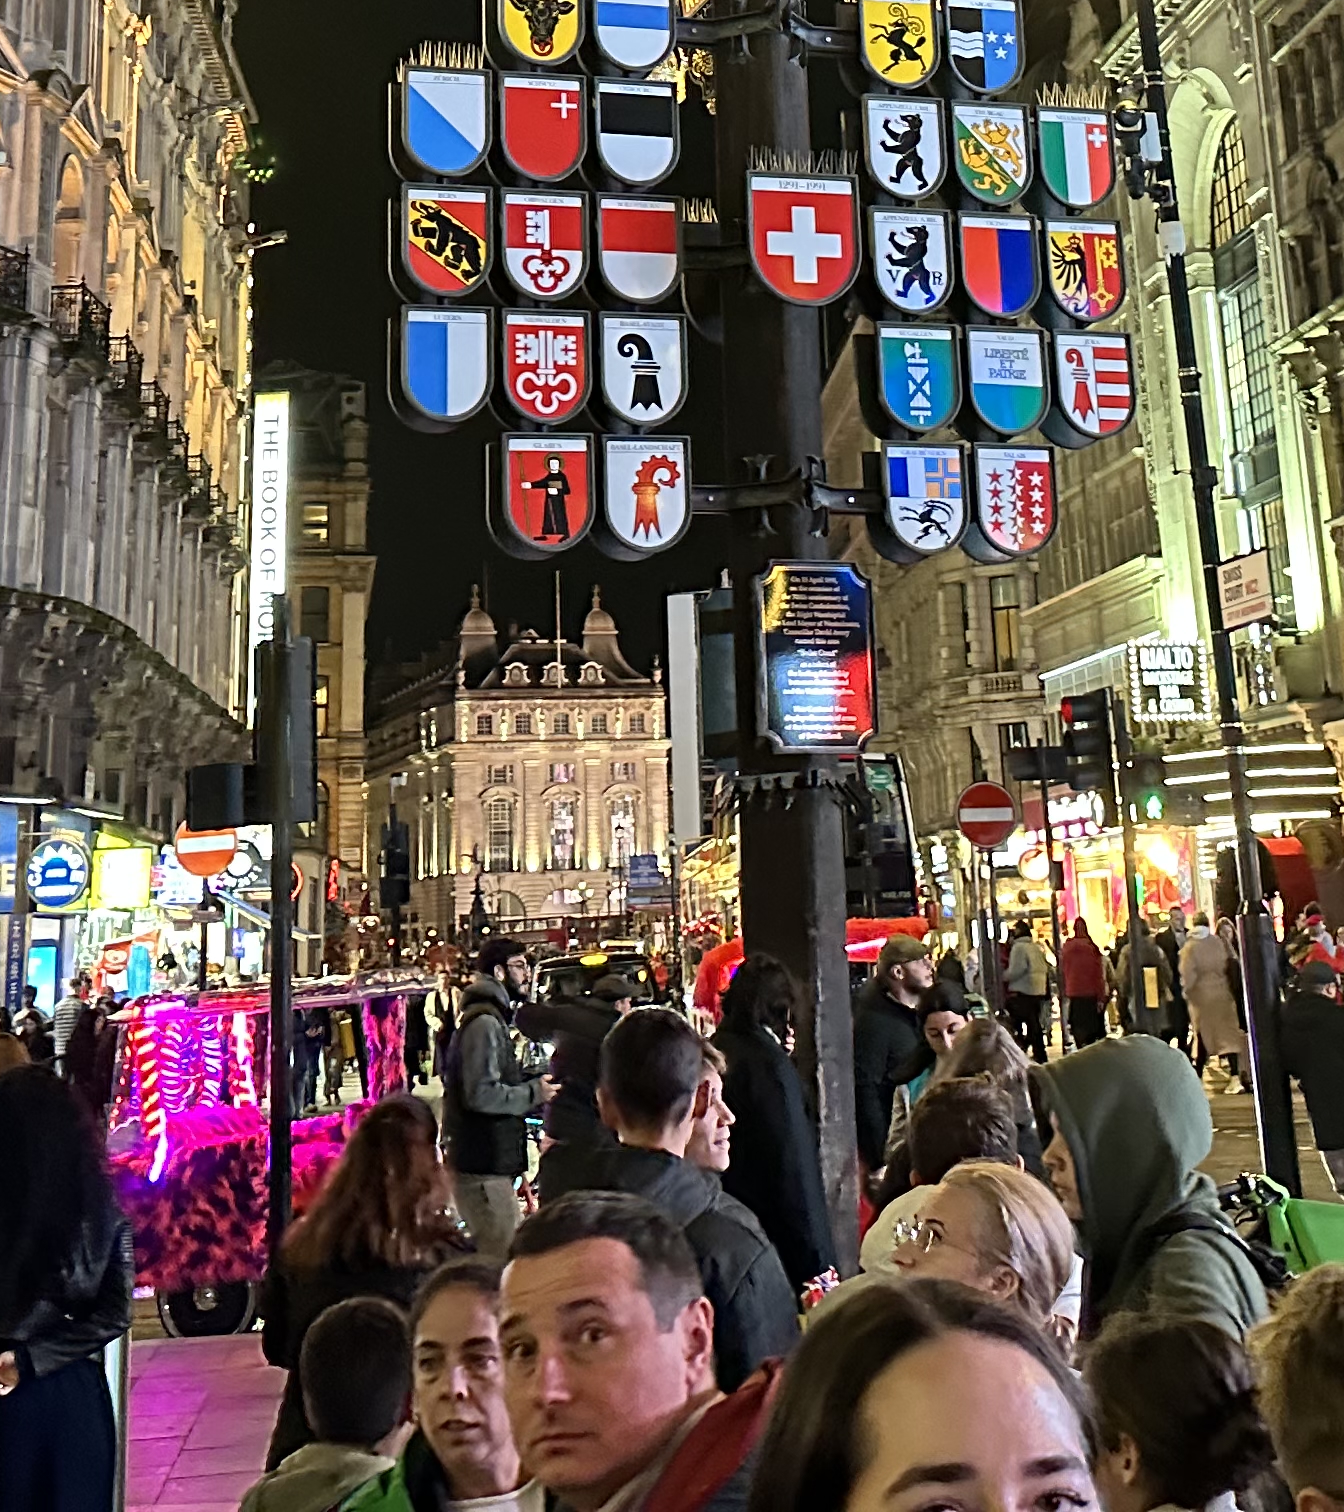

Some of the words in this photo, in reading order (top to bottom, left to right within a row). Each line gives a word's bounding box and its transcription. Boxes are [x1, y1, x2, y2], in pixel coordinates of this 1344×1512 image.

[886, 269, 901, 283] V
[932, 271, 944, 286] R
[984, 348, 1030, 361] LIBERTÉ
[1000, 359, 1016, 370] ET
[988, 368, 1027, 380] PATRIE
[262, 415, 279, 460] THE
[261, 470, 278, 541] BOOK
[259, 548, 276, 582] OF
[1139, 646, 1194, 670] RIALTO
